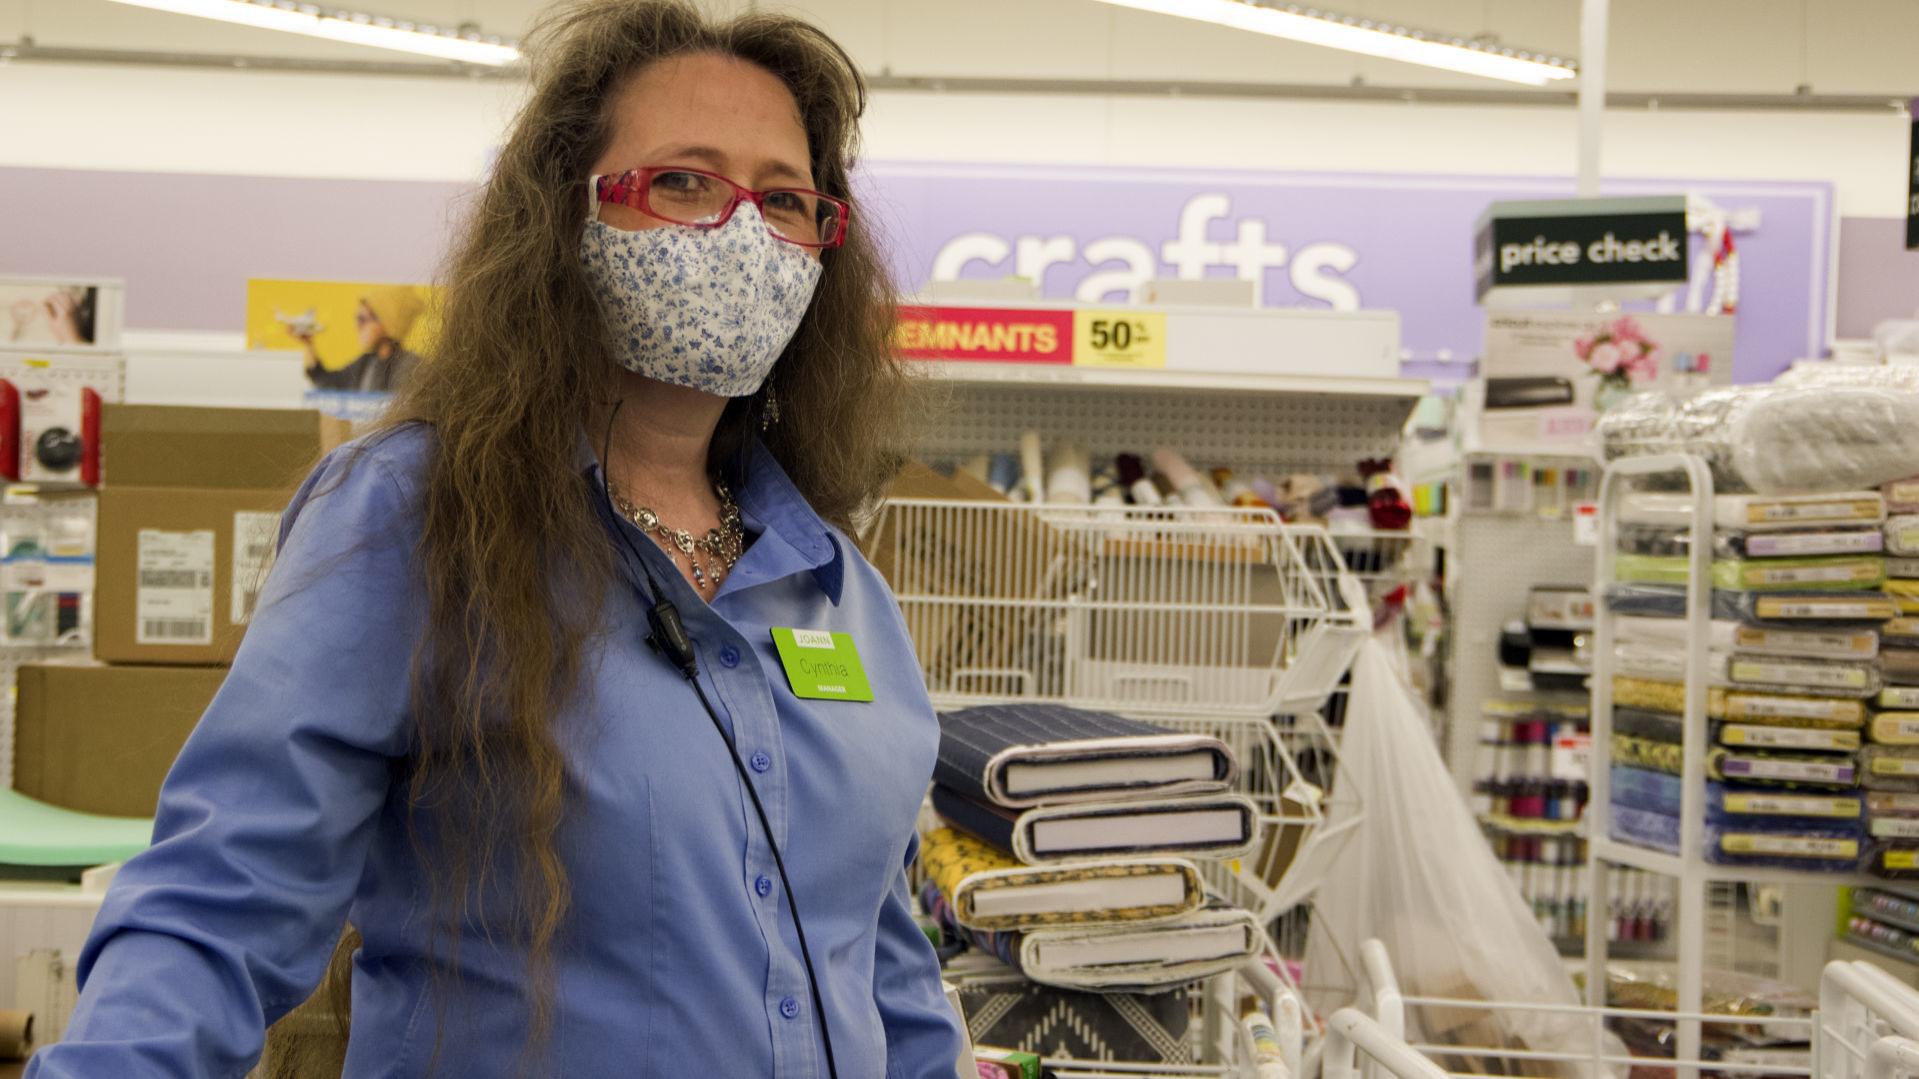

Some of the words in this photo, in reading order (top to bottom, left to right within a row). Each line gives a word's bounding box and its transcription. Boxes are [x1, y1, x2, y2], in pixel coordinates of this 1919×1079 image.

[932, 193, 1361, 312] crafts
[1501, 235, 1581, 274] price
[1588, 230, 1680, 264] check
[894, 320, 1058, 353] EMNANTS
[1090, 319, 1131, 351] 50
[800, 632, 832, 645] JOANN
[800, 657, 848, 678] Cynthia
